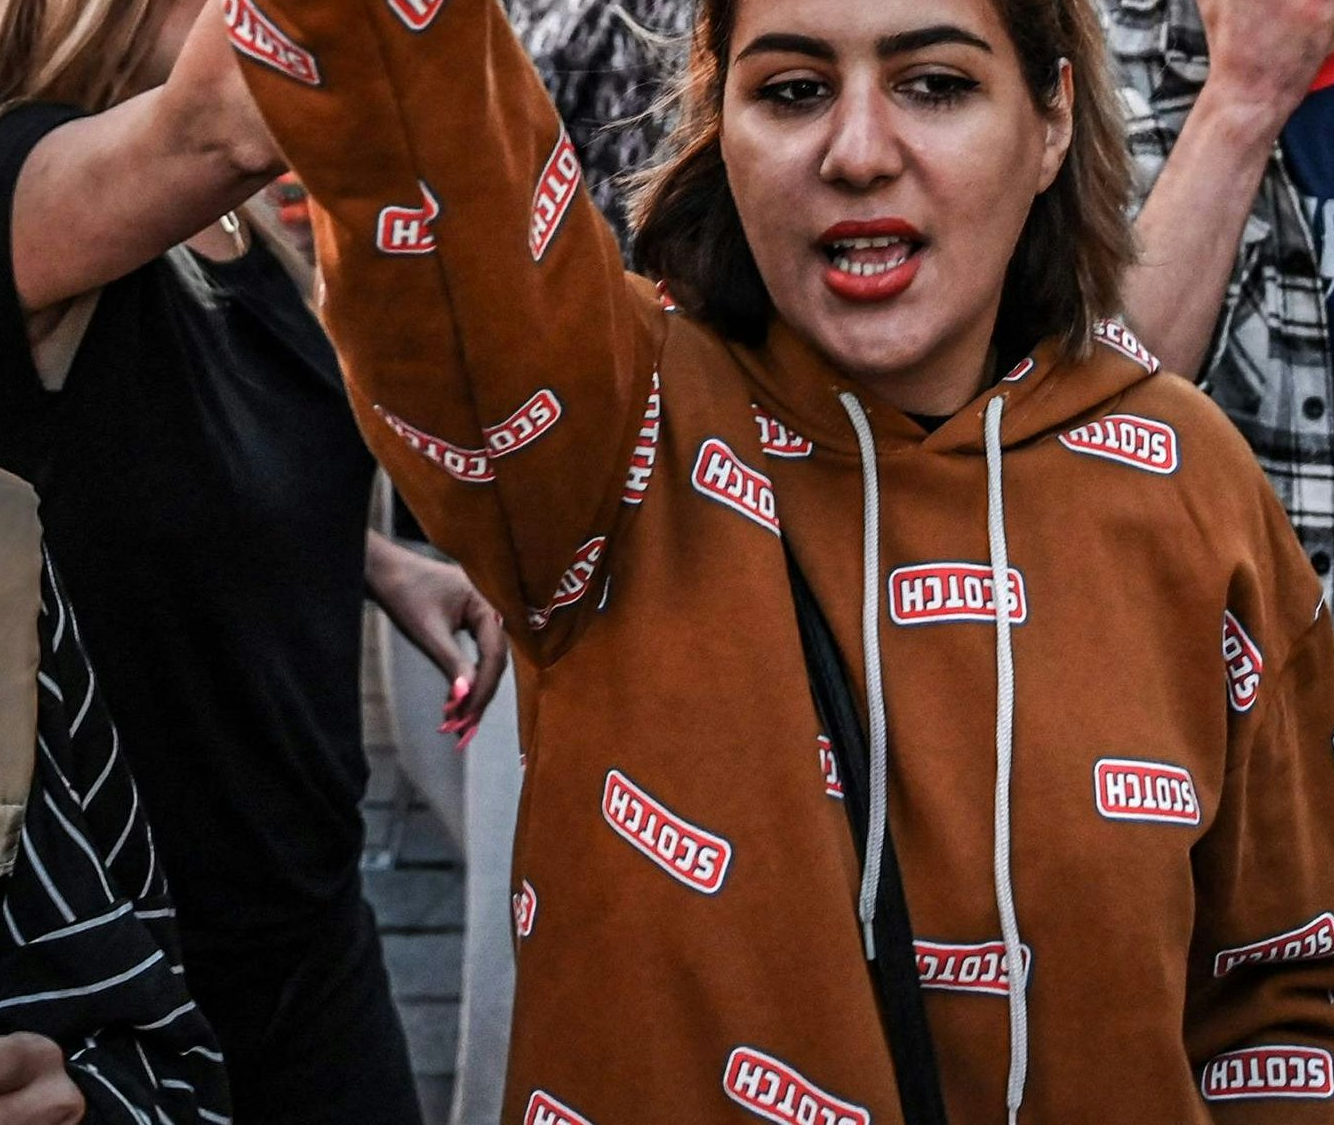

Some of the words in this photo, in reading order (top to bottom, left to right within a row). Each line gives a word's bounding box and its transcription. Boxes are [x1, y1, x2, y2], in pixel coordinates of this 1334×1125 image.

[703, 451, 778, 522] OTCH
[1223, 624, 1260, 699] SCO
[1106, 772, 1195, 814] SCOTCH
[608, 783, 719, 881] SCOTCH
[1210, 1056, 1326, 1090] SCOTCH
